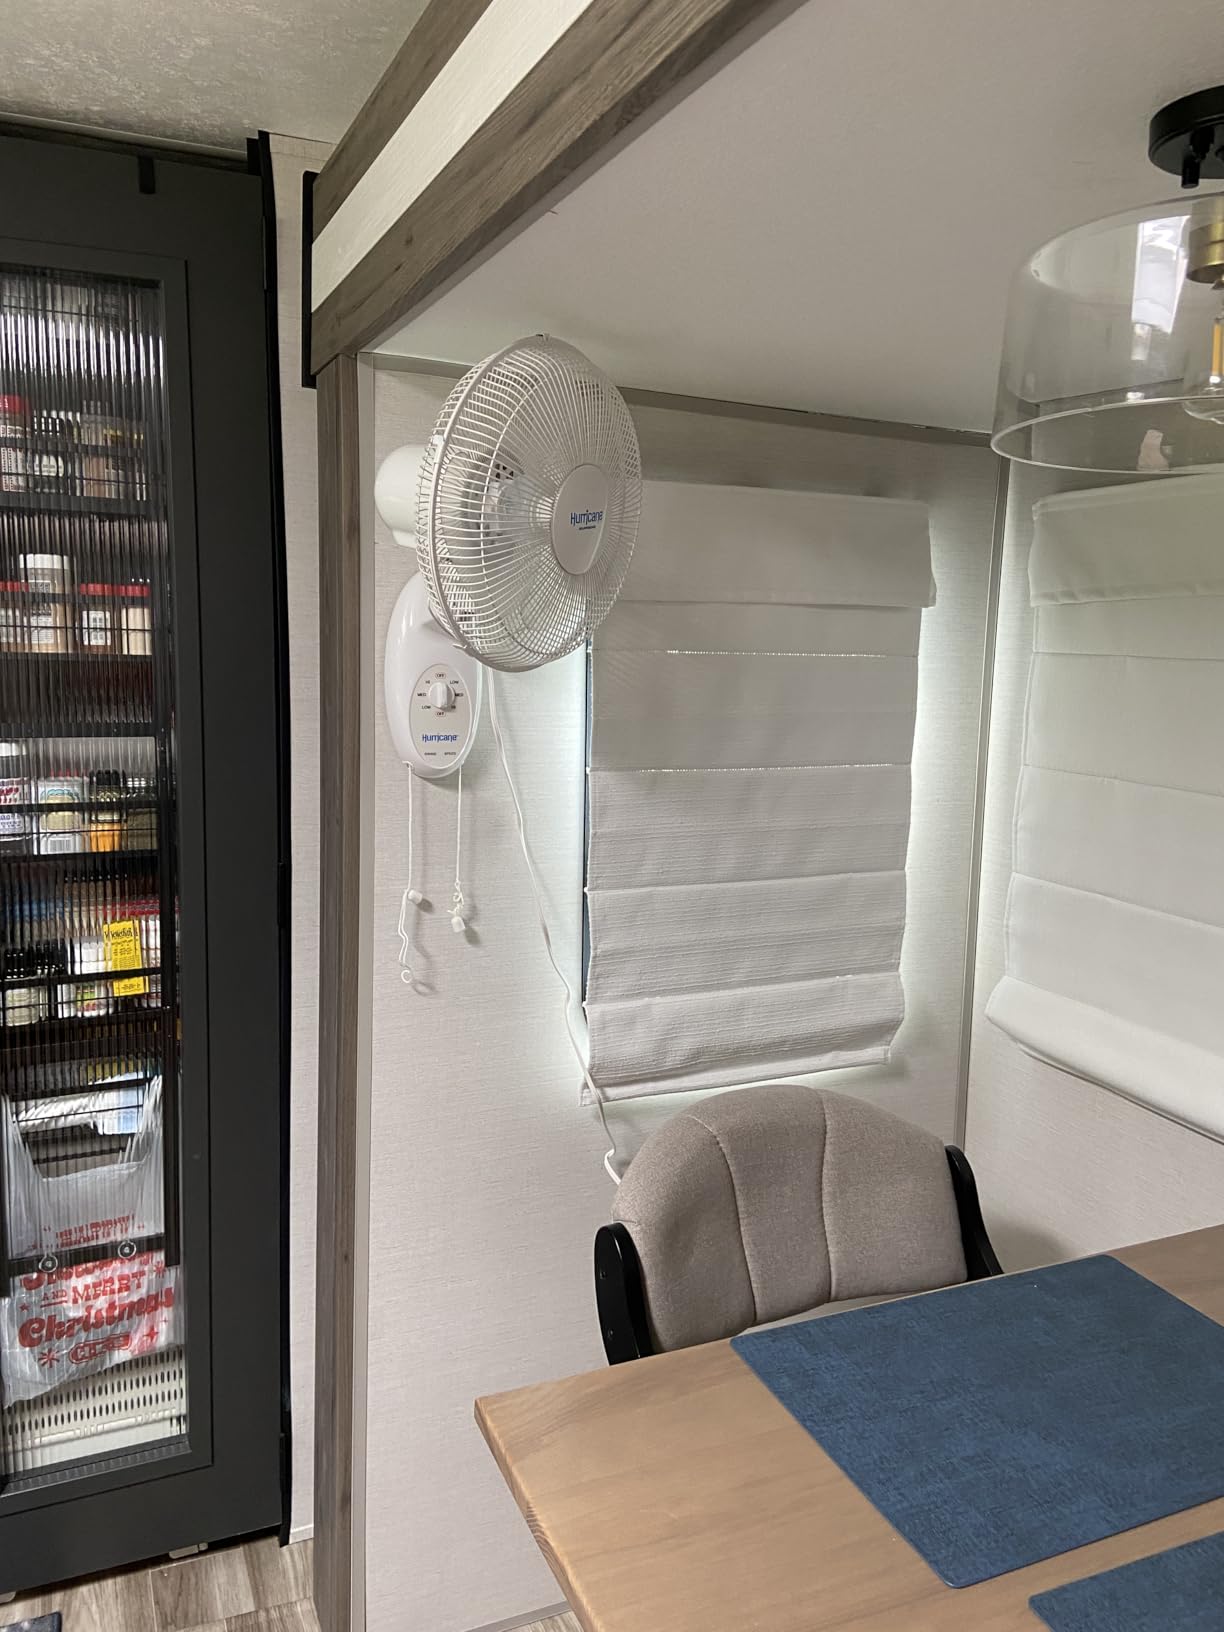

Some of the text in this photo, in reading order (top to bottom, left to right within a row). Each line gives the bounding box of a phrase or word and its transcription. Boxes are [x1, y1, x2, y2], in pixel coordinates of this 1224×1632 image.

[570, 509, 603, 526] Hurricane
[422, 734, 458, 743] Hurricane
[41, 1289, 67, 1302] AND
[71, 1271, 146, 1304] MERRY
[18, 1287, 175, 1348] Christmas
